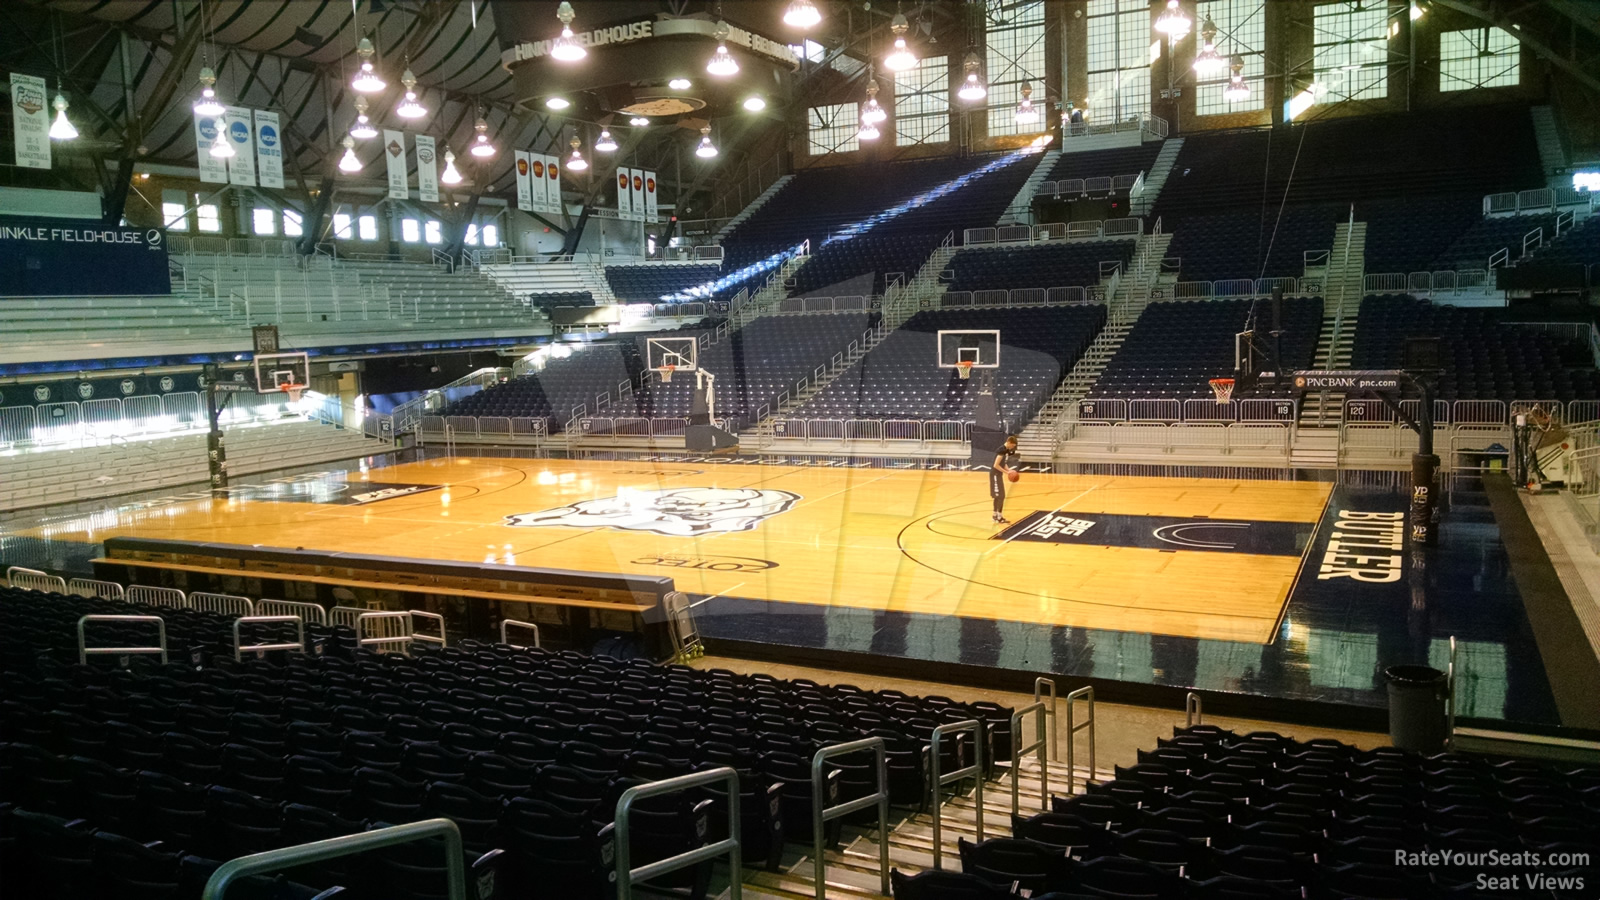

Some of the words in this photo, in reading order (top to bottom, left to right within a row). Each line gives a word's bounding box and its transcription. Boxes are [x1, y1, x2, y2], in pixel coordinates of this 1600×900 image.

[52, 229, 143, 244] FIELDHOUSE
[1359, 380, 1397, 388] pnc.com
[1084, 405, 1094, 414] 119
[1277, 406, 1289, 414] 119
[1350, 407, 1365, 416] 120
[1030, 515, 1075, 540] EAST
[1059, 519, 1097, 537] BIG
[1317, 510, 1405, 583] BUTLER
